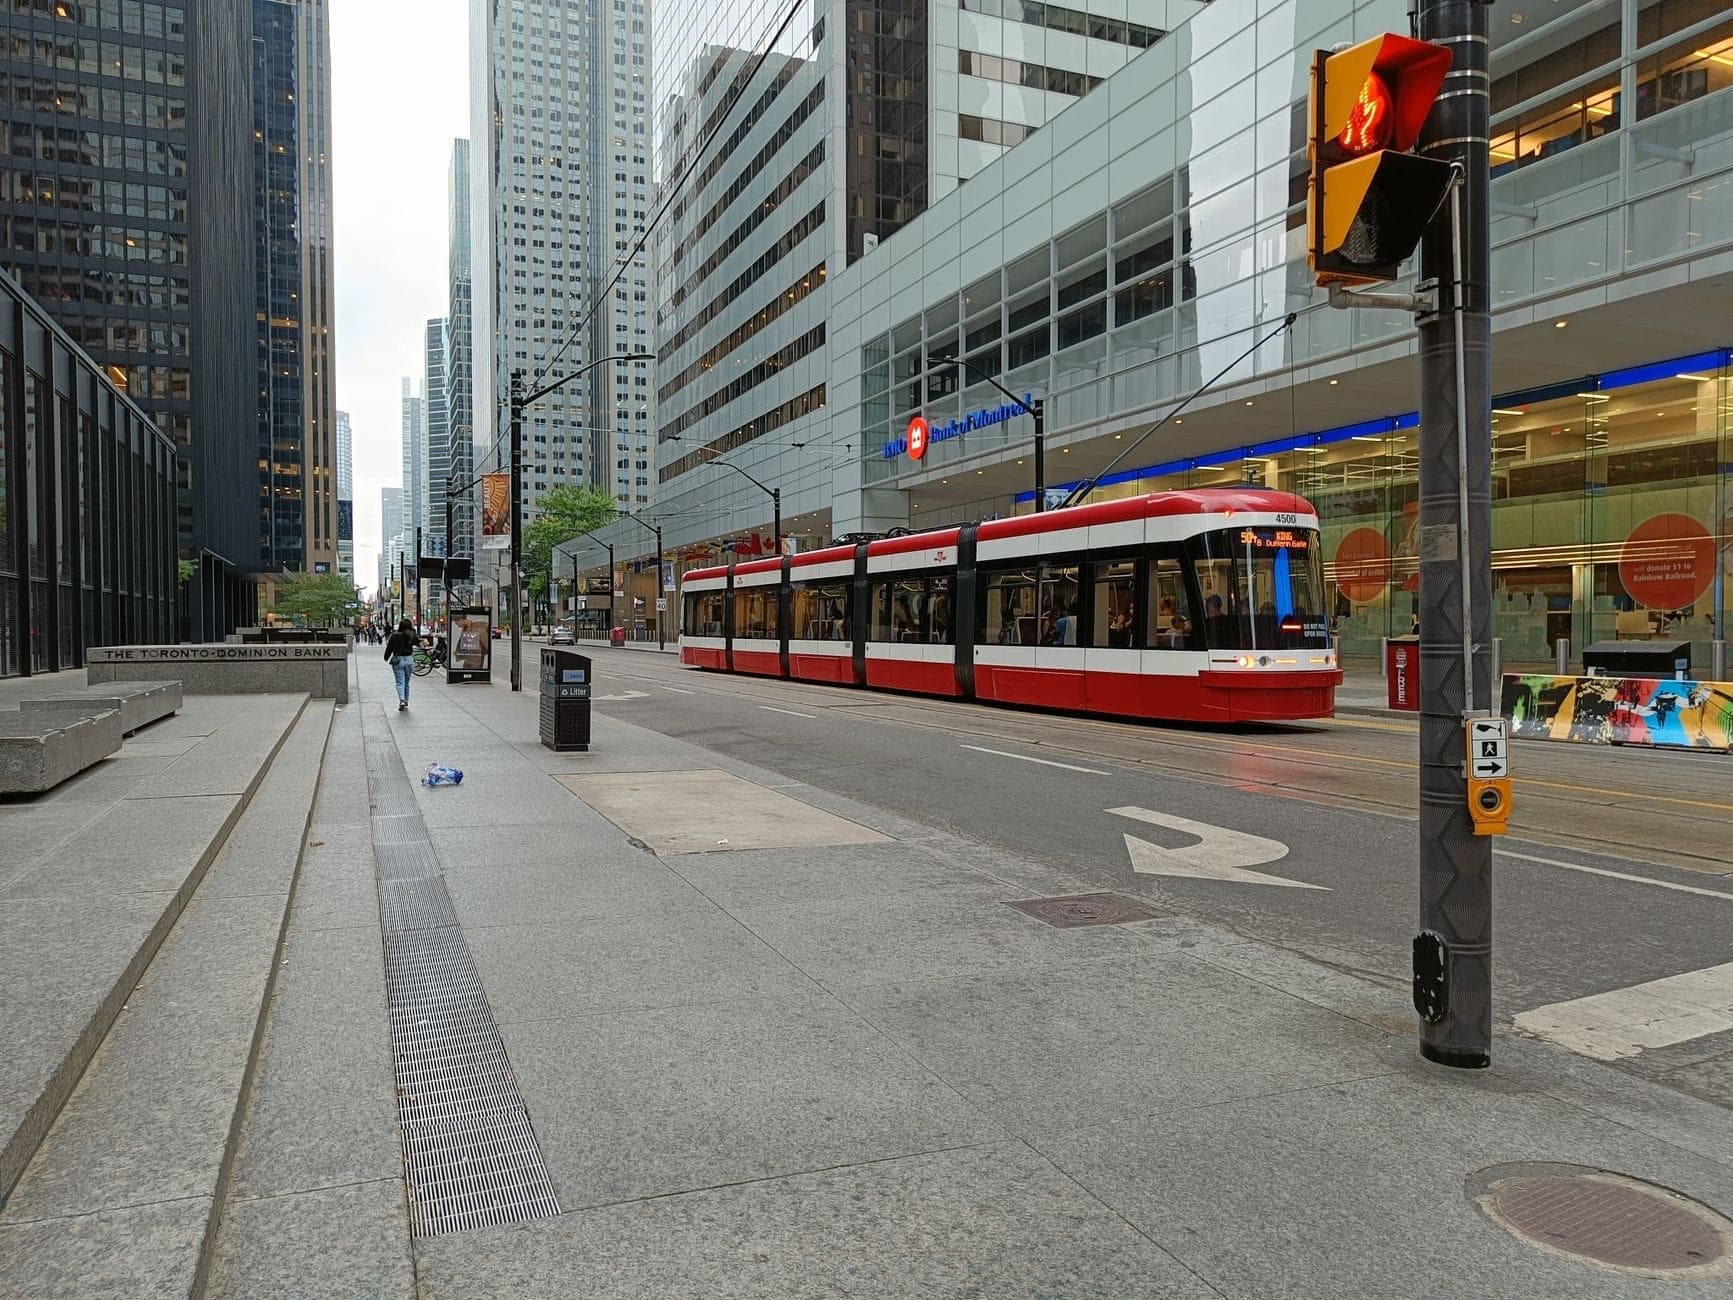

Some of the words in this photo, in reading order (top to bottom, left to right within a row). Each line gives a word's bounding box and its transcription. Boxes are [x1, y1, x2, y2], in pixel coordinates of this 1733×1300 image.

[930, 418, 959, 443] Bank
[959, 413, 972, 434] of
[972, 393, 1032, 430] Montreal
[483, 477, 491, 509] BEAUTY
[1276, 514, 1296, 524] 4500
[1276, 531, 1293, 541] KING
[1647, 563, 1671, 571] donate
[1673, 563, 1681, 571] $1
[1633, 573, 1664, 582] Rainbow
[1664, 571, 1698, 580] Railroad.
[105, 650, 134, 659] THE
[140, 648, 287, 658] TORONTO-DOMINION
[294, 648, 332, 657] BANK
[570, 687, 587, 696] Litter
